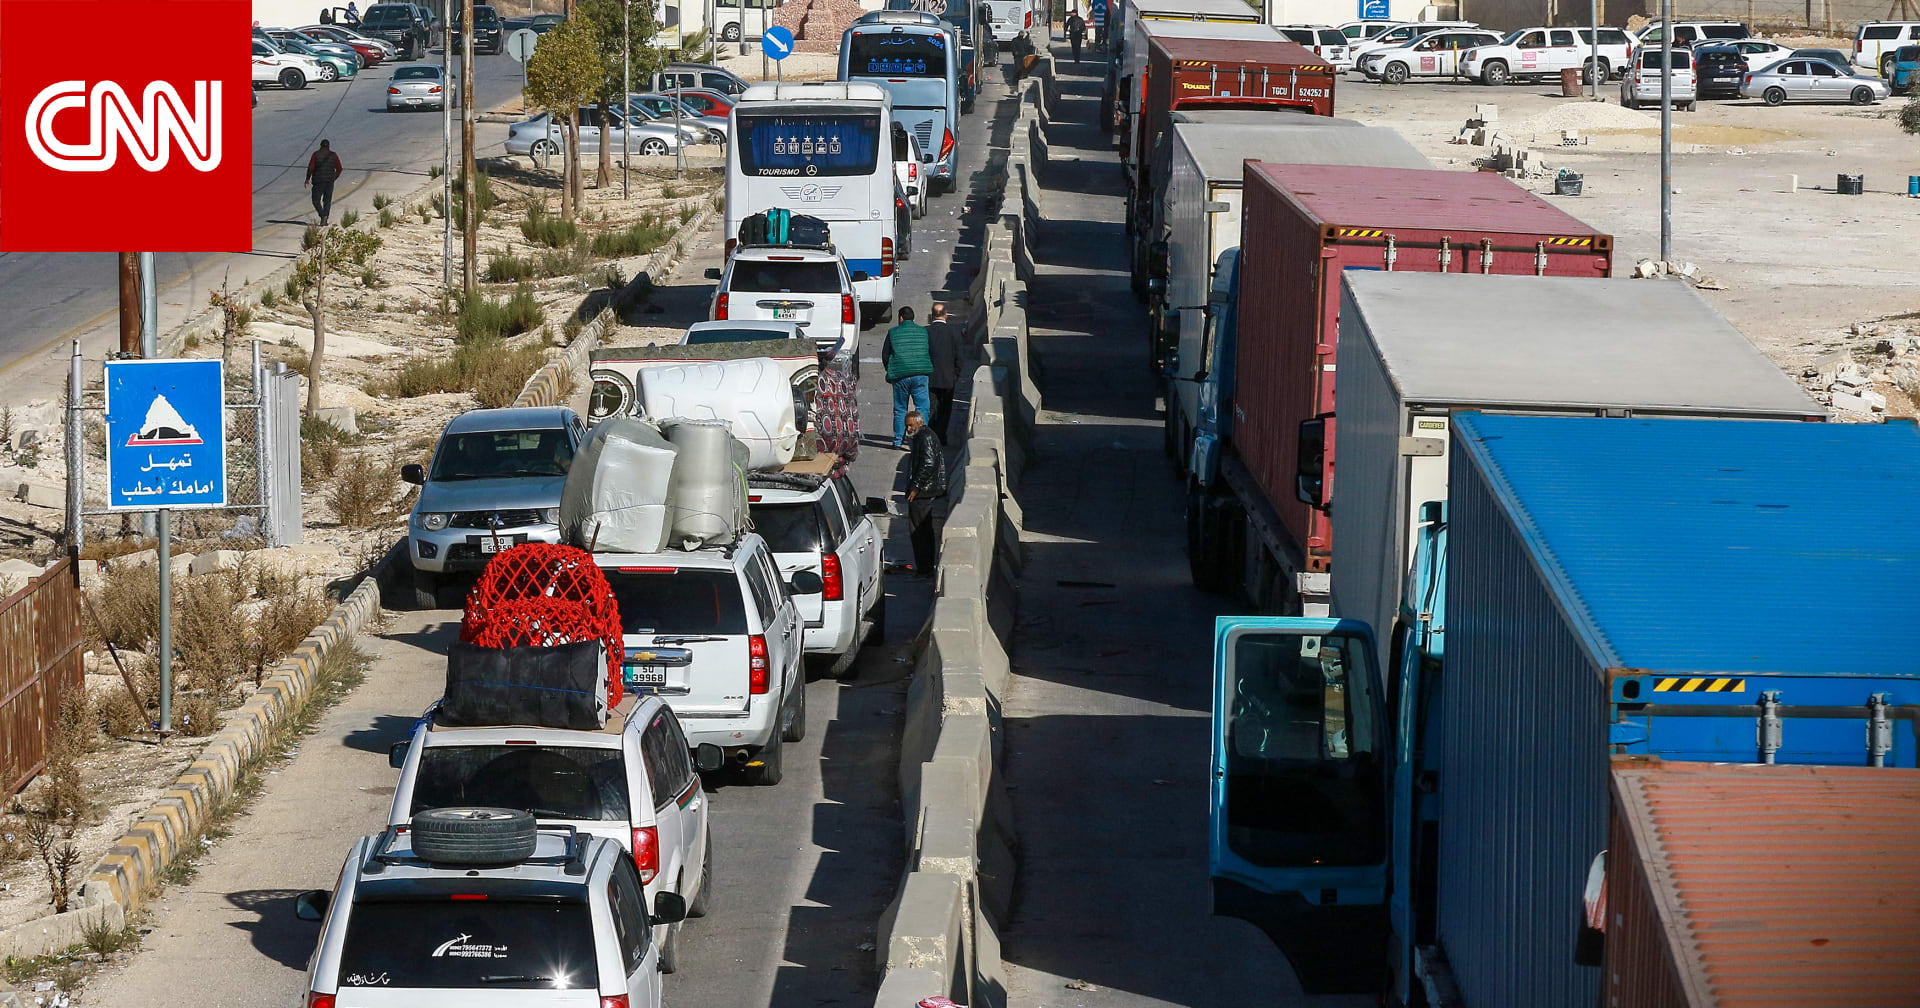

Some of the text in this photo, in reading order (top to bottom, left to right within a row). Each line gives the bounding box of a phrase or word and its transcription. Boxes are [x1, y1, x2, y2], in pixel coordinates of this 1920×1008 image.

[1272, 86, 1288, 96] TGCU
[757, 168, 800, 176] TOURISMO
[140, 453, 193, 472] تمهل
[168, 480, 214, 495] امامك
[633, 674, 663, 682] 39968
